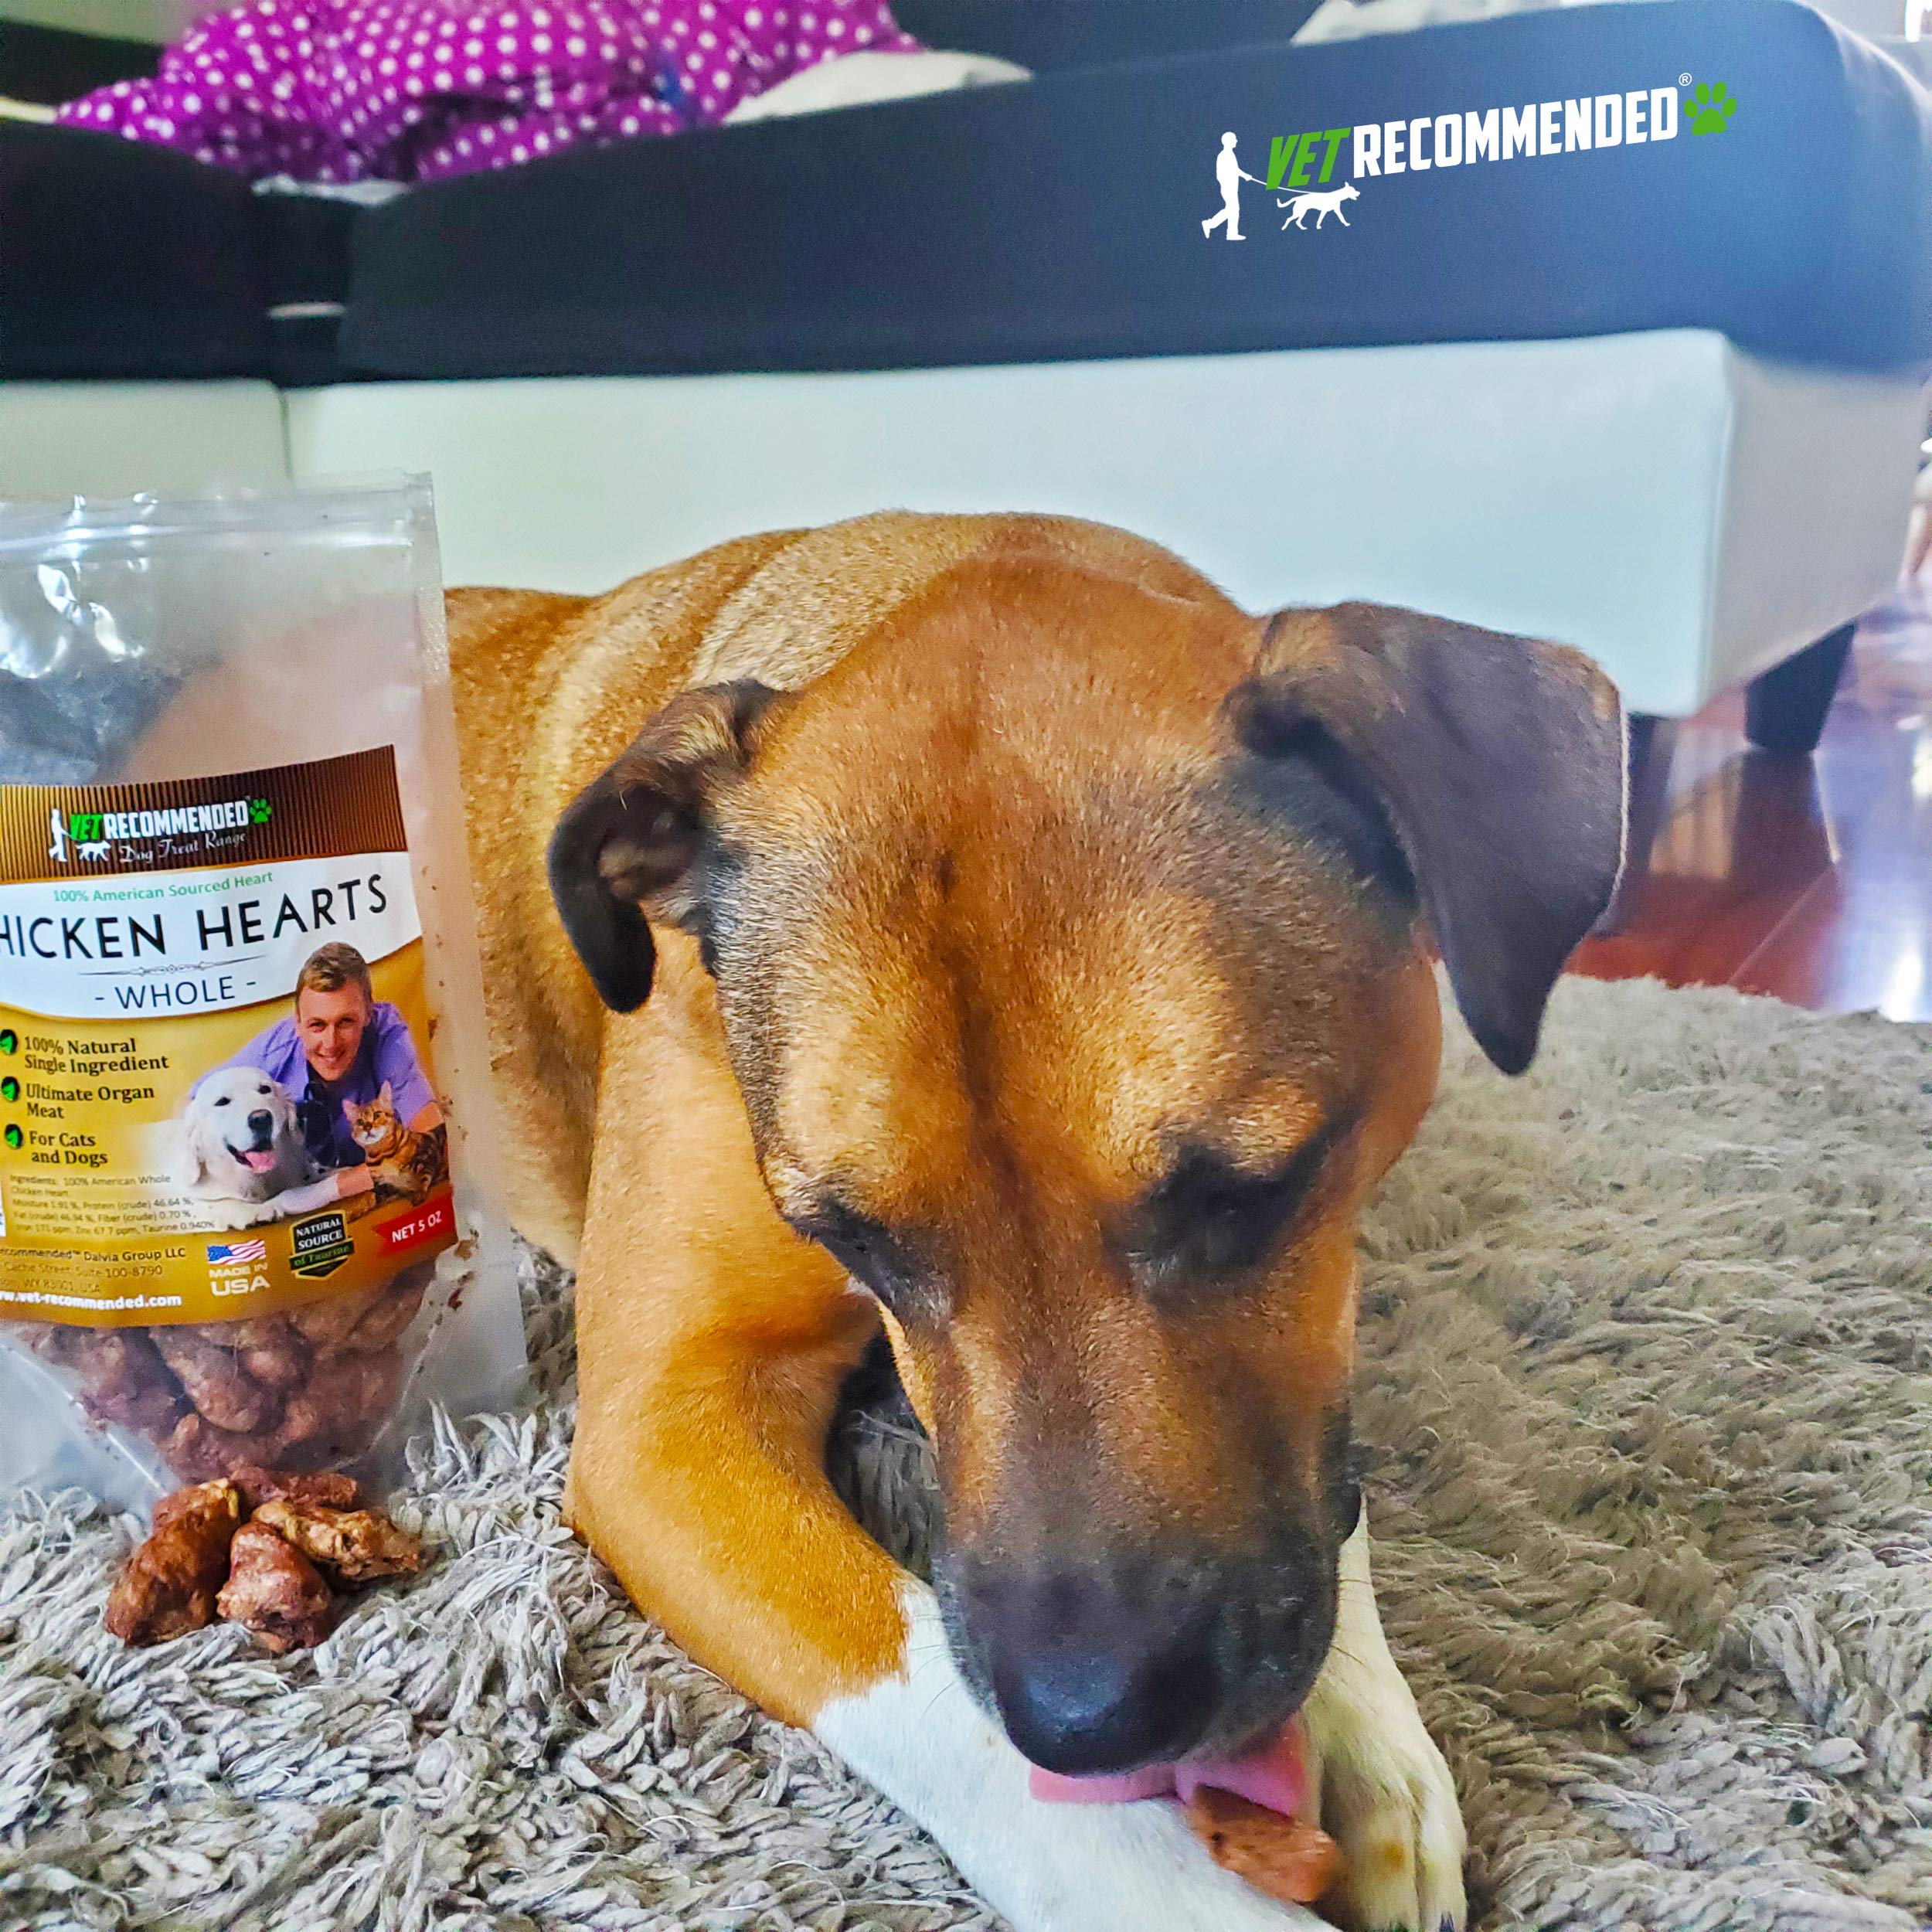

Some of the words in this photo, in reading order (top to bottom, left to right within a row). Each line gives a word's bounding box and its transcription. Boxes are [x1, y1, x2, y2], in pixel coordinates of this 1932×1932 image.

[104, 801, 249, 839] RECOMMENDED
[120, 845, 153, 863] Dog
[158, 839, 198, 859] Treat
[206, 831, 247, 849] Range
[53, 890, 89, 902] 100%
[94, 888, 165, 901] American
[169, 879, 230, 897] Sourced
[235, 871, 273, 886] Heart
[197, 873, 386, 951] HEARTS
[25, 1036, 63, 1055] 100%
[67, 1038, 136, 1055] Natural
[25, 1054, 66, 1075] Single
[70, 1056, 169, 1077] Ingredient
[26, 1083, 93, 1101] Ultimate
[98, 1086, 155, 1104] Organ
[27, 1103, 64, 1119] Meat
[29, 1131, 55, 1146] For
[60, 1133, 96, 1147] Cats
[32, 1150, 60, 1164] and
[65, 1151, 108, 1168] Dogs
[91, 1177, 135, 1186] American
[138, 1173, 172, 1185] Whole
[141, 1223, 178, 1234] Taurine
[296, 1217, 342, 1237] NATURAL
[392, 1225, 416, 1243] NET
[418, 1219, 426, 1233] 5
[298, 1229, 343, 1250] SOURCE
[122, 1250, 162, 1262] Group
[165, 1247, 186, 1258] LLC
[209, 1267, 251, 1279] MADE
[254, 1261, 269, 1272] IN
[210, 1275, 270, 1297] USA
